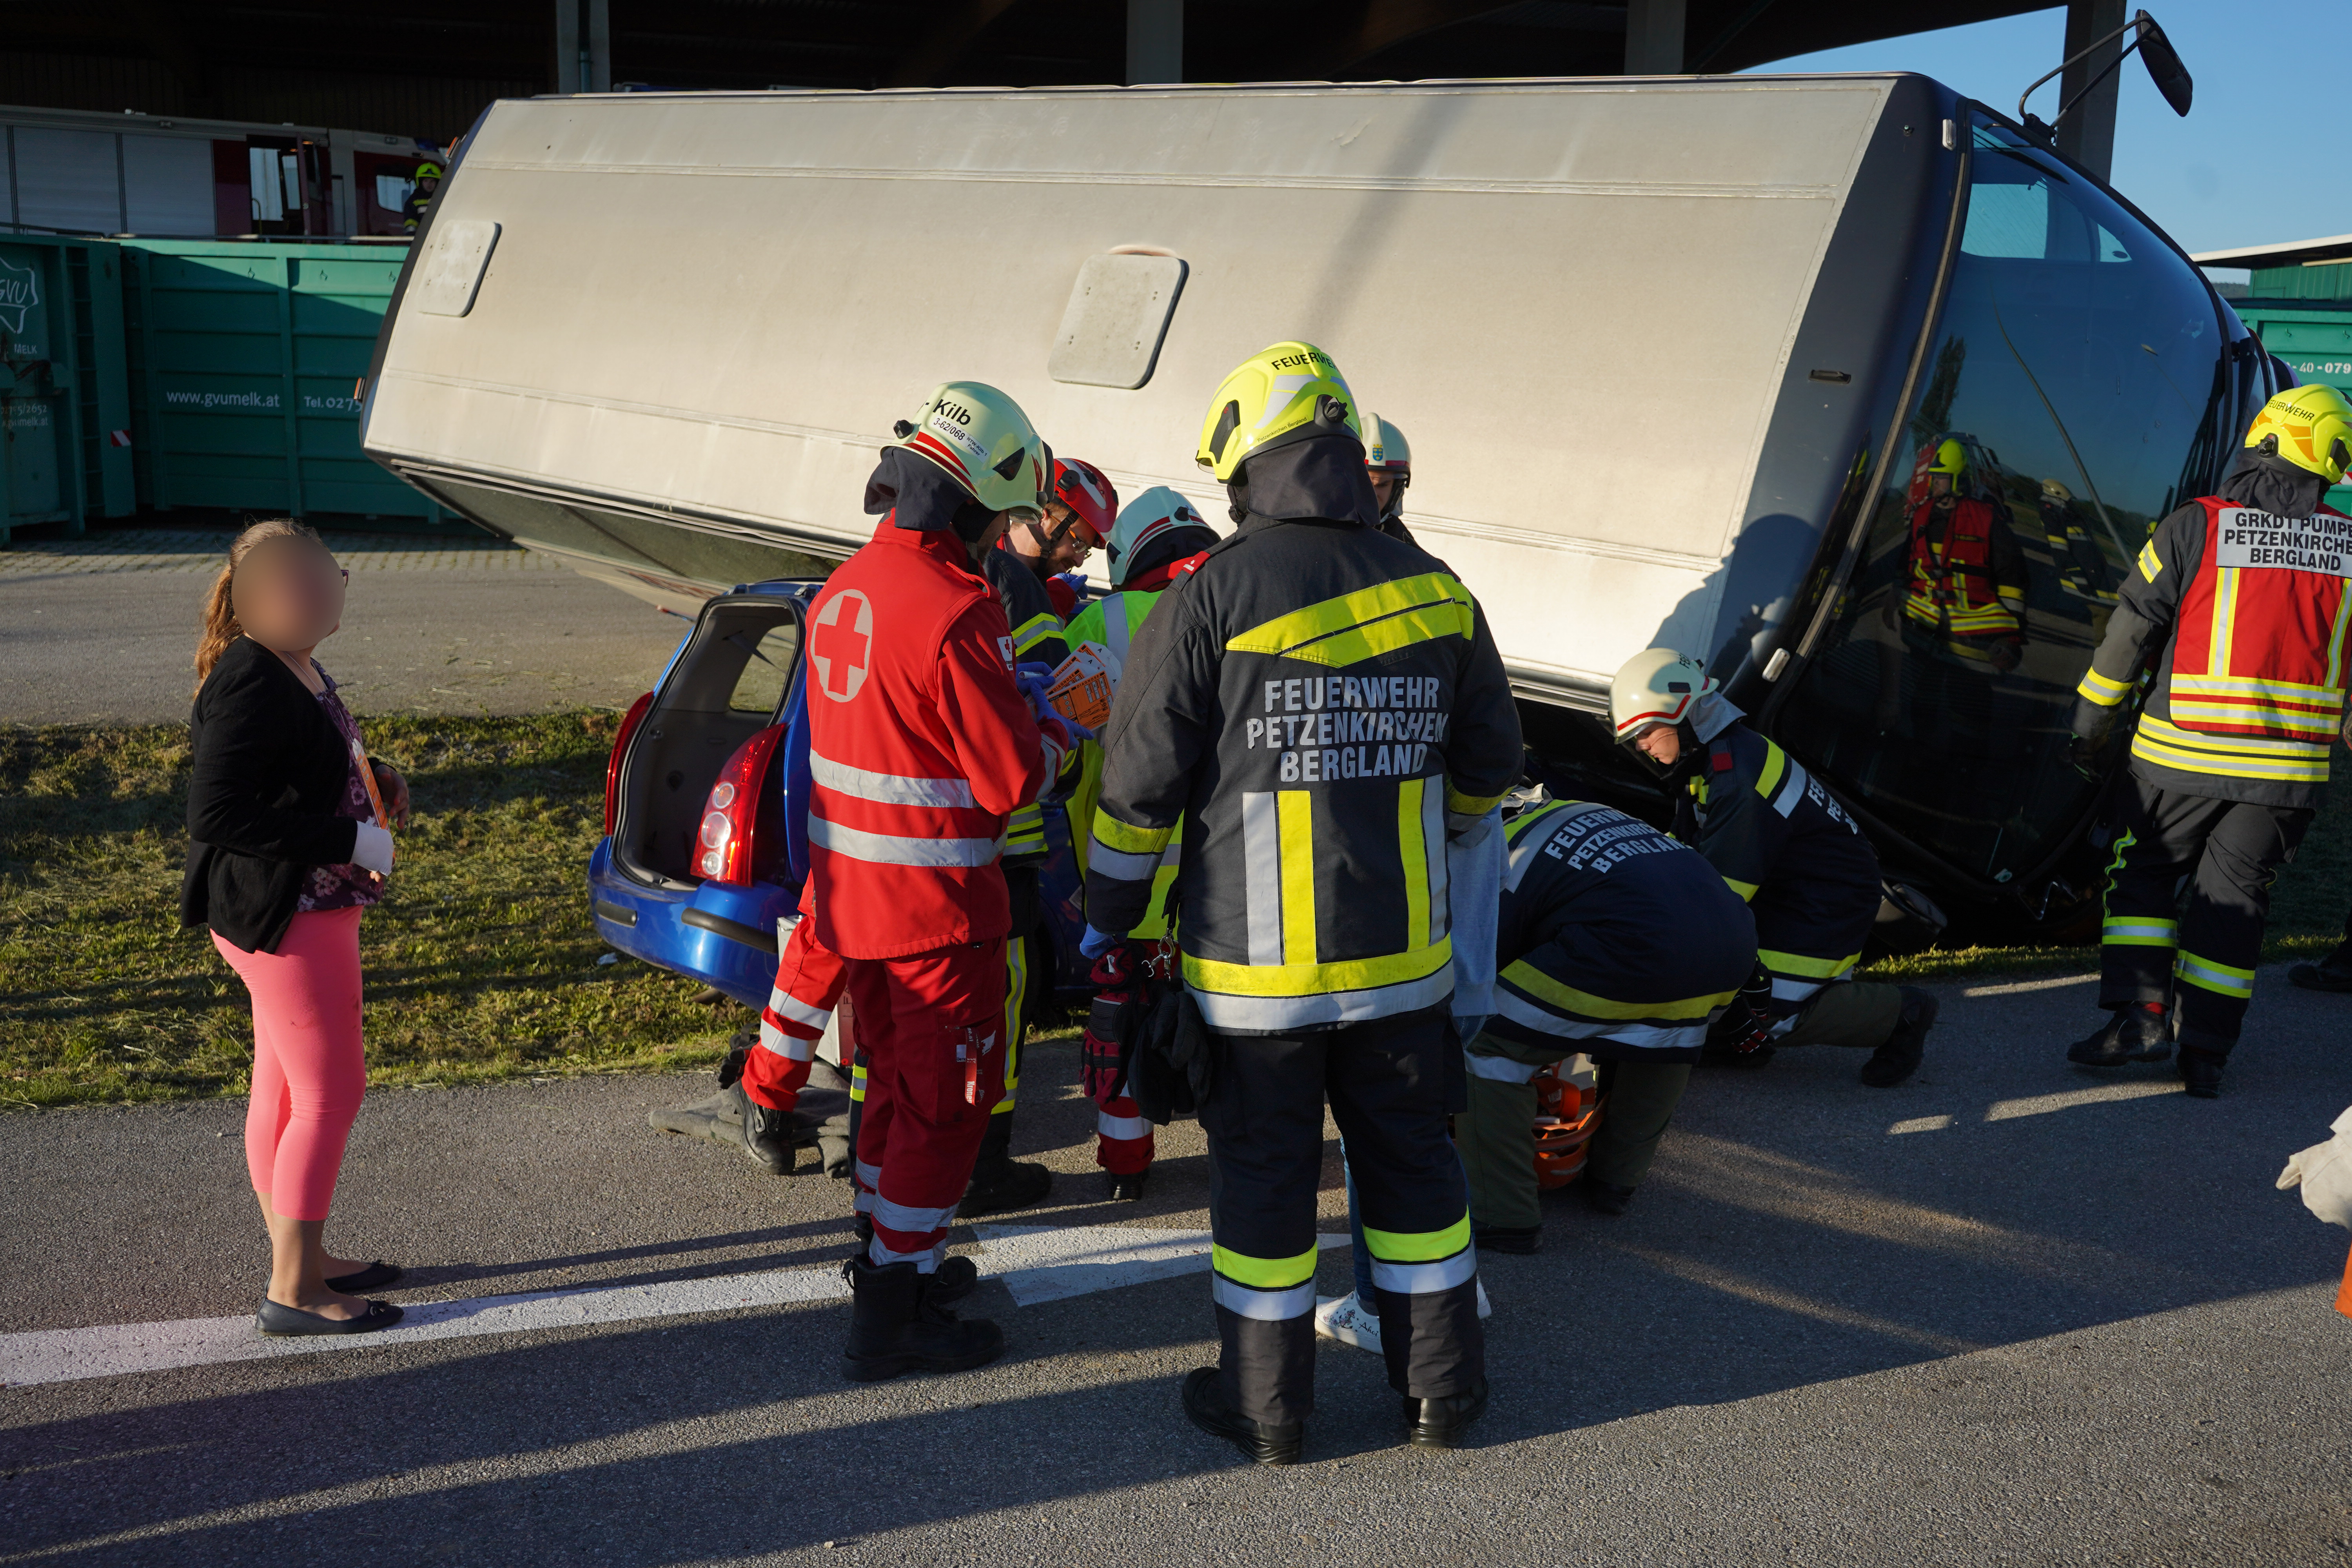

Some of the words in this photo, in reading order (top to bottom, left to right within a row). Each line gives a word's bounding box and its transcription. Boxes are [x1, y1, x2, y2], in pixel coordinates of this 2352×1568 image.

[14, 343, 37, 354] MELK
[167, 391, 279, 408] www.gvumelk.at
[304, 396, 324, 408] Tel.
[2267, 399, 2315, 421] FEUERWEHR
[933, 399, 971, 425] Kilb
[933, 418, 965, 440] 3-62/068
[1257, 426, 1287, 443] Petzenkirchen
[1287, 417, 1307, 428] Bergland
[967, 437, 984, 454] RTW-Kilb
[967, 444, 980, 456] Fahrer
[2236, 512, 2293, 529] GRKDT
[2250, 548, 2341, 571] BERGLAND
[1053, 674, 1075, 691] DIAGNOSE
[1076, 674, 1100, 688] DIAGNOSE
[1265, 677, 1439, 712] FEUERWEHR
[1247, 711, 1448, 749] PETZENKIRCHEN
[1280, 743, 1428, 782] BERGLAND
[1544, 809, 1633, 860] FEUERW
[1567, 823, 1661, 871] PETZENKIRC
[1590, 836, 1690, 874] BERGLAN
